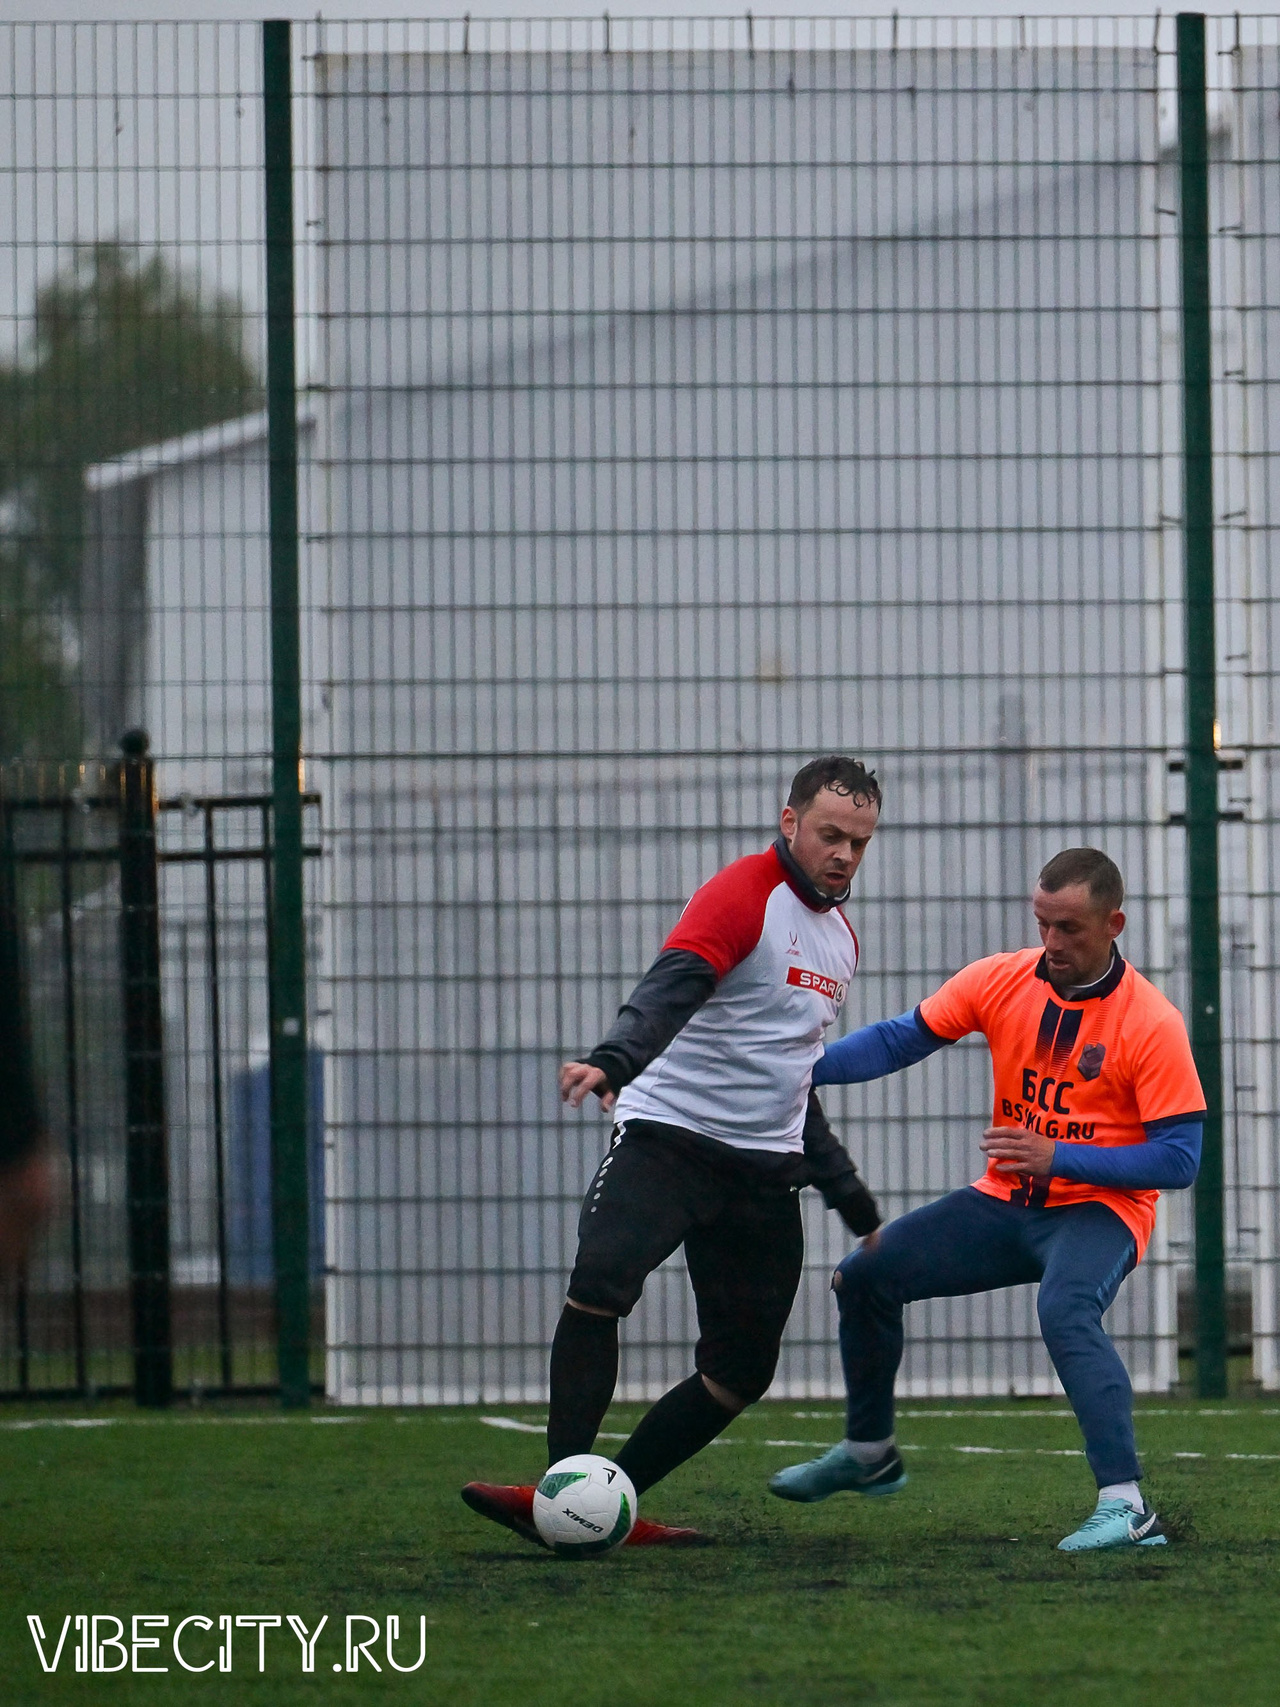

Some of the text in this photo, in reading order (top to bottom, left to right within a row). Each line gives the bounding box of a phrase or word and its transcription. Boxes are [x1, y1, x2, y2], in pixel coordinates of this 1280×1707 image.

[799, 971, 836, 996] SPAR
[1021, 1067, 1075, 1115] БСС
[561, 1507, 605, 1534] DEMIX
